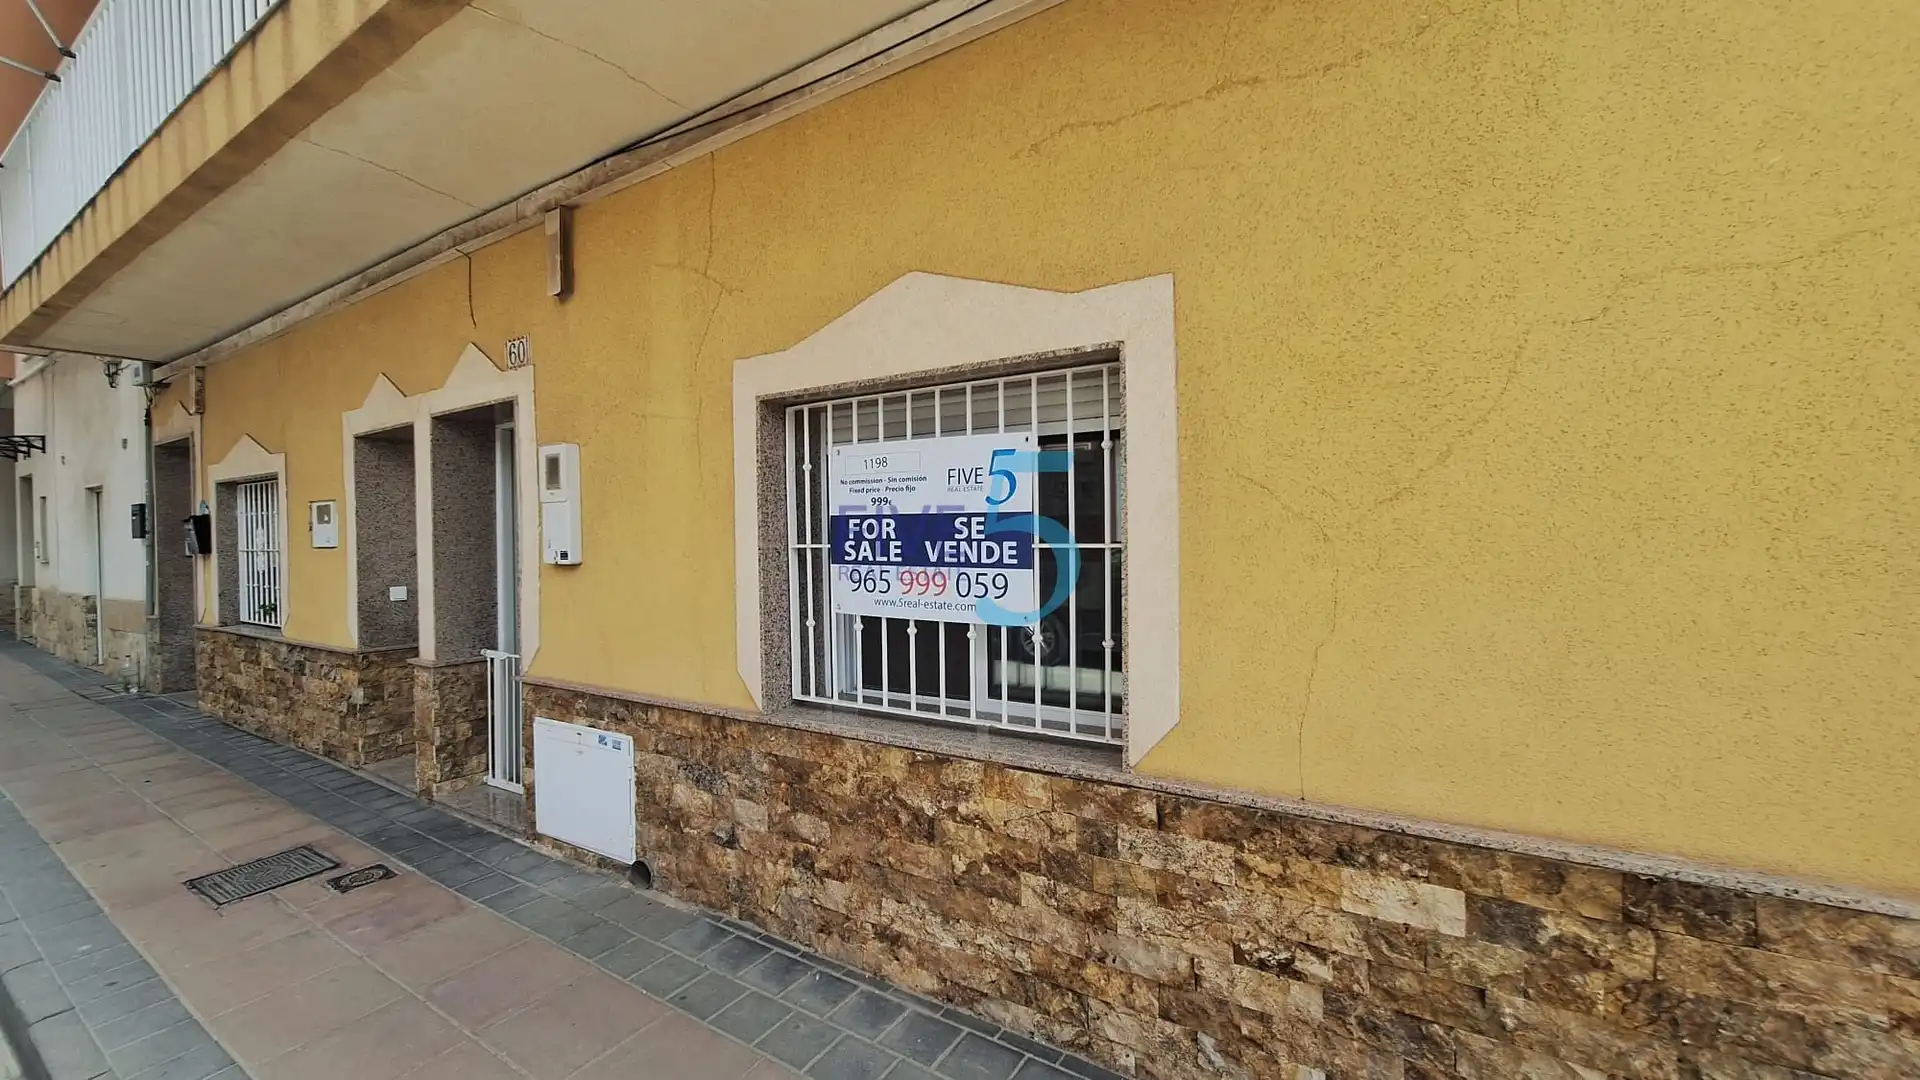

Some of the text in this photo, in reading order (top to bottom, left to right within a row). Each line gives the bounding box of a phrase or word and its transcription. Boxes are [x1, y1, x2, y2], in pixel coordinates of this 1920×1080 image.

[509, 341, 525, 365] 60
[864, 457, 888, 470] 1198
[898, 474, 927, 483] comisión
[947, 467, 984, 485] FIVE
[985, 448, 1017, 506] 5
[865, 487, 880, 495] price
[884, 485, 904, 493] Precio
[905, 484, 916, 493] fijo
[962, 485, 984, 493] ESTATE
[848, 518, 897, 540] FOR
[954, 516, 986, 540] SE
[844, 540, 903, 562] SALE
[924, 540, 1018, 564] VENDE
[850, 568, 1009, 600] 965 999 059
[873, 598, 976, 612] www.5real-estate.com
